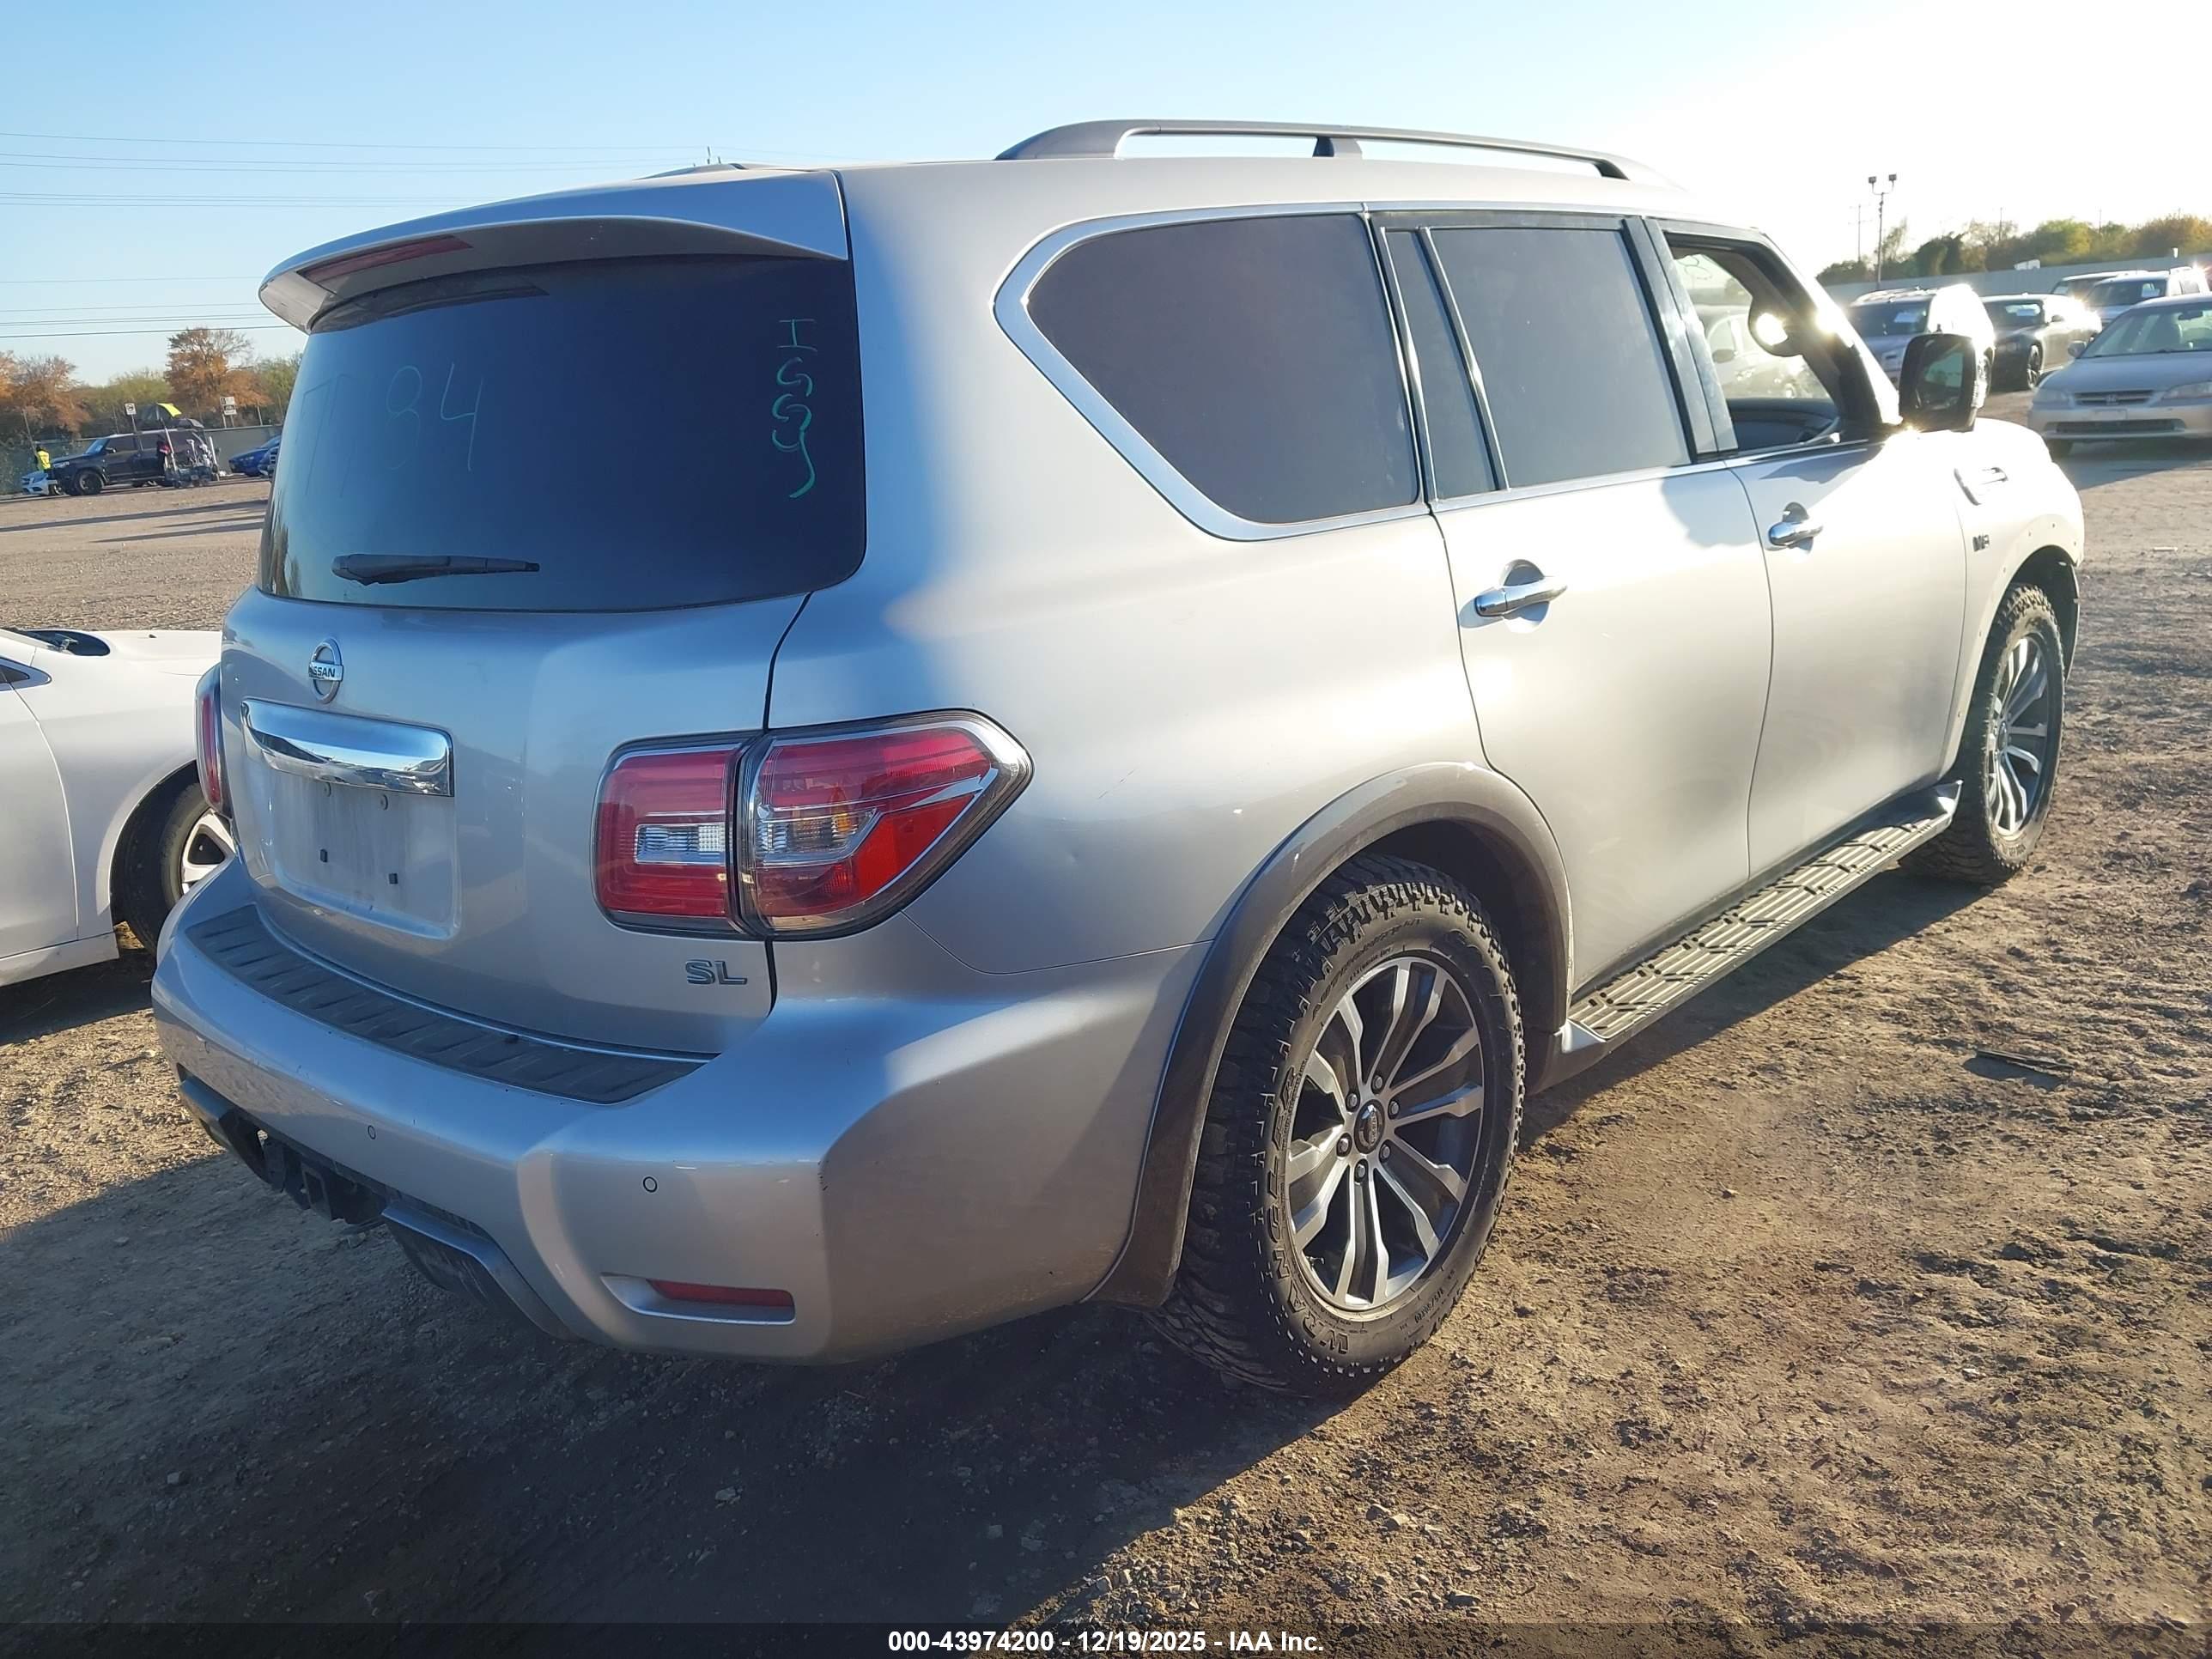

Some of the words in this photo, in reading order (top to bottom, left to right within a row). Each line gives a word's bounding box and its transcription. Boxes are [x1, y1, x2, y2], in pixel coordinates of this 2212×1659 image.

[309, 665, 336, 678] SSAN
[685, 959, 748, 985] SL
[1267, 1066, 1349, 1355] WRANGLER
